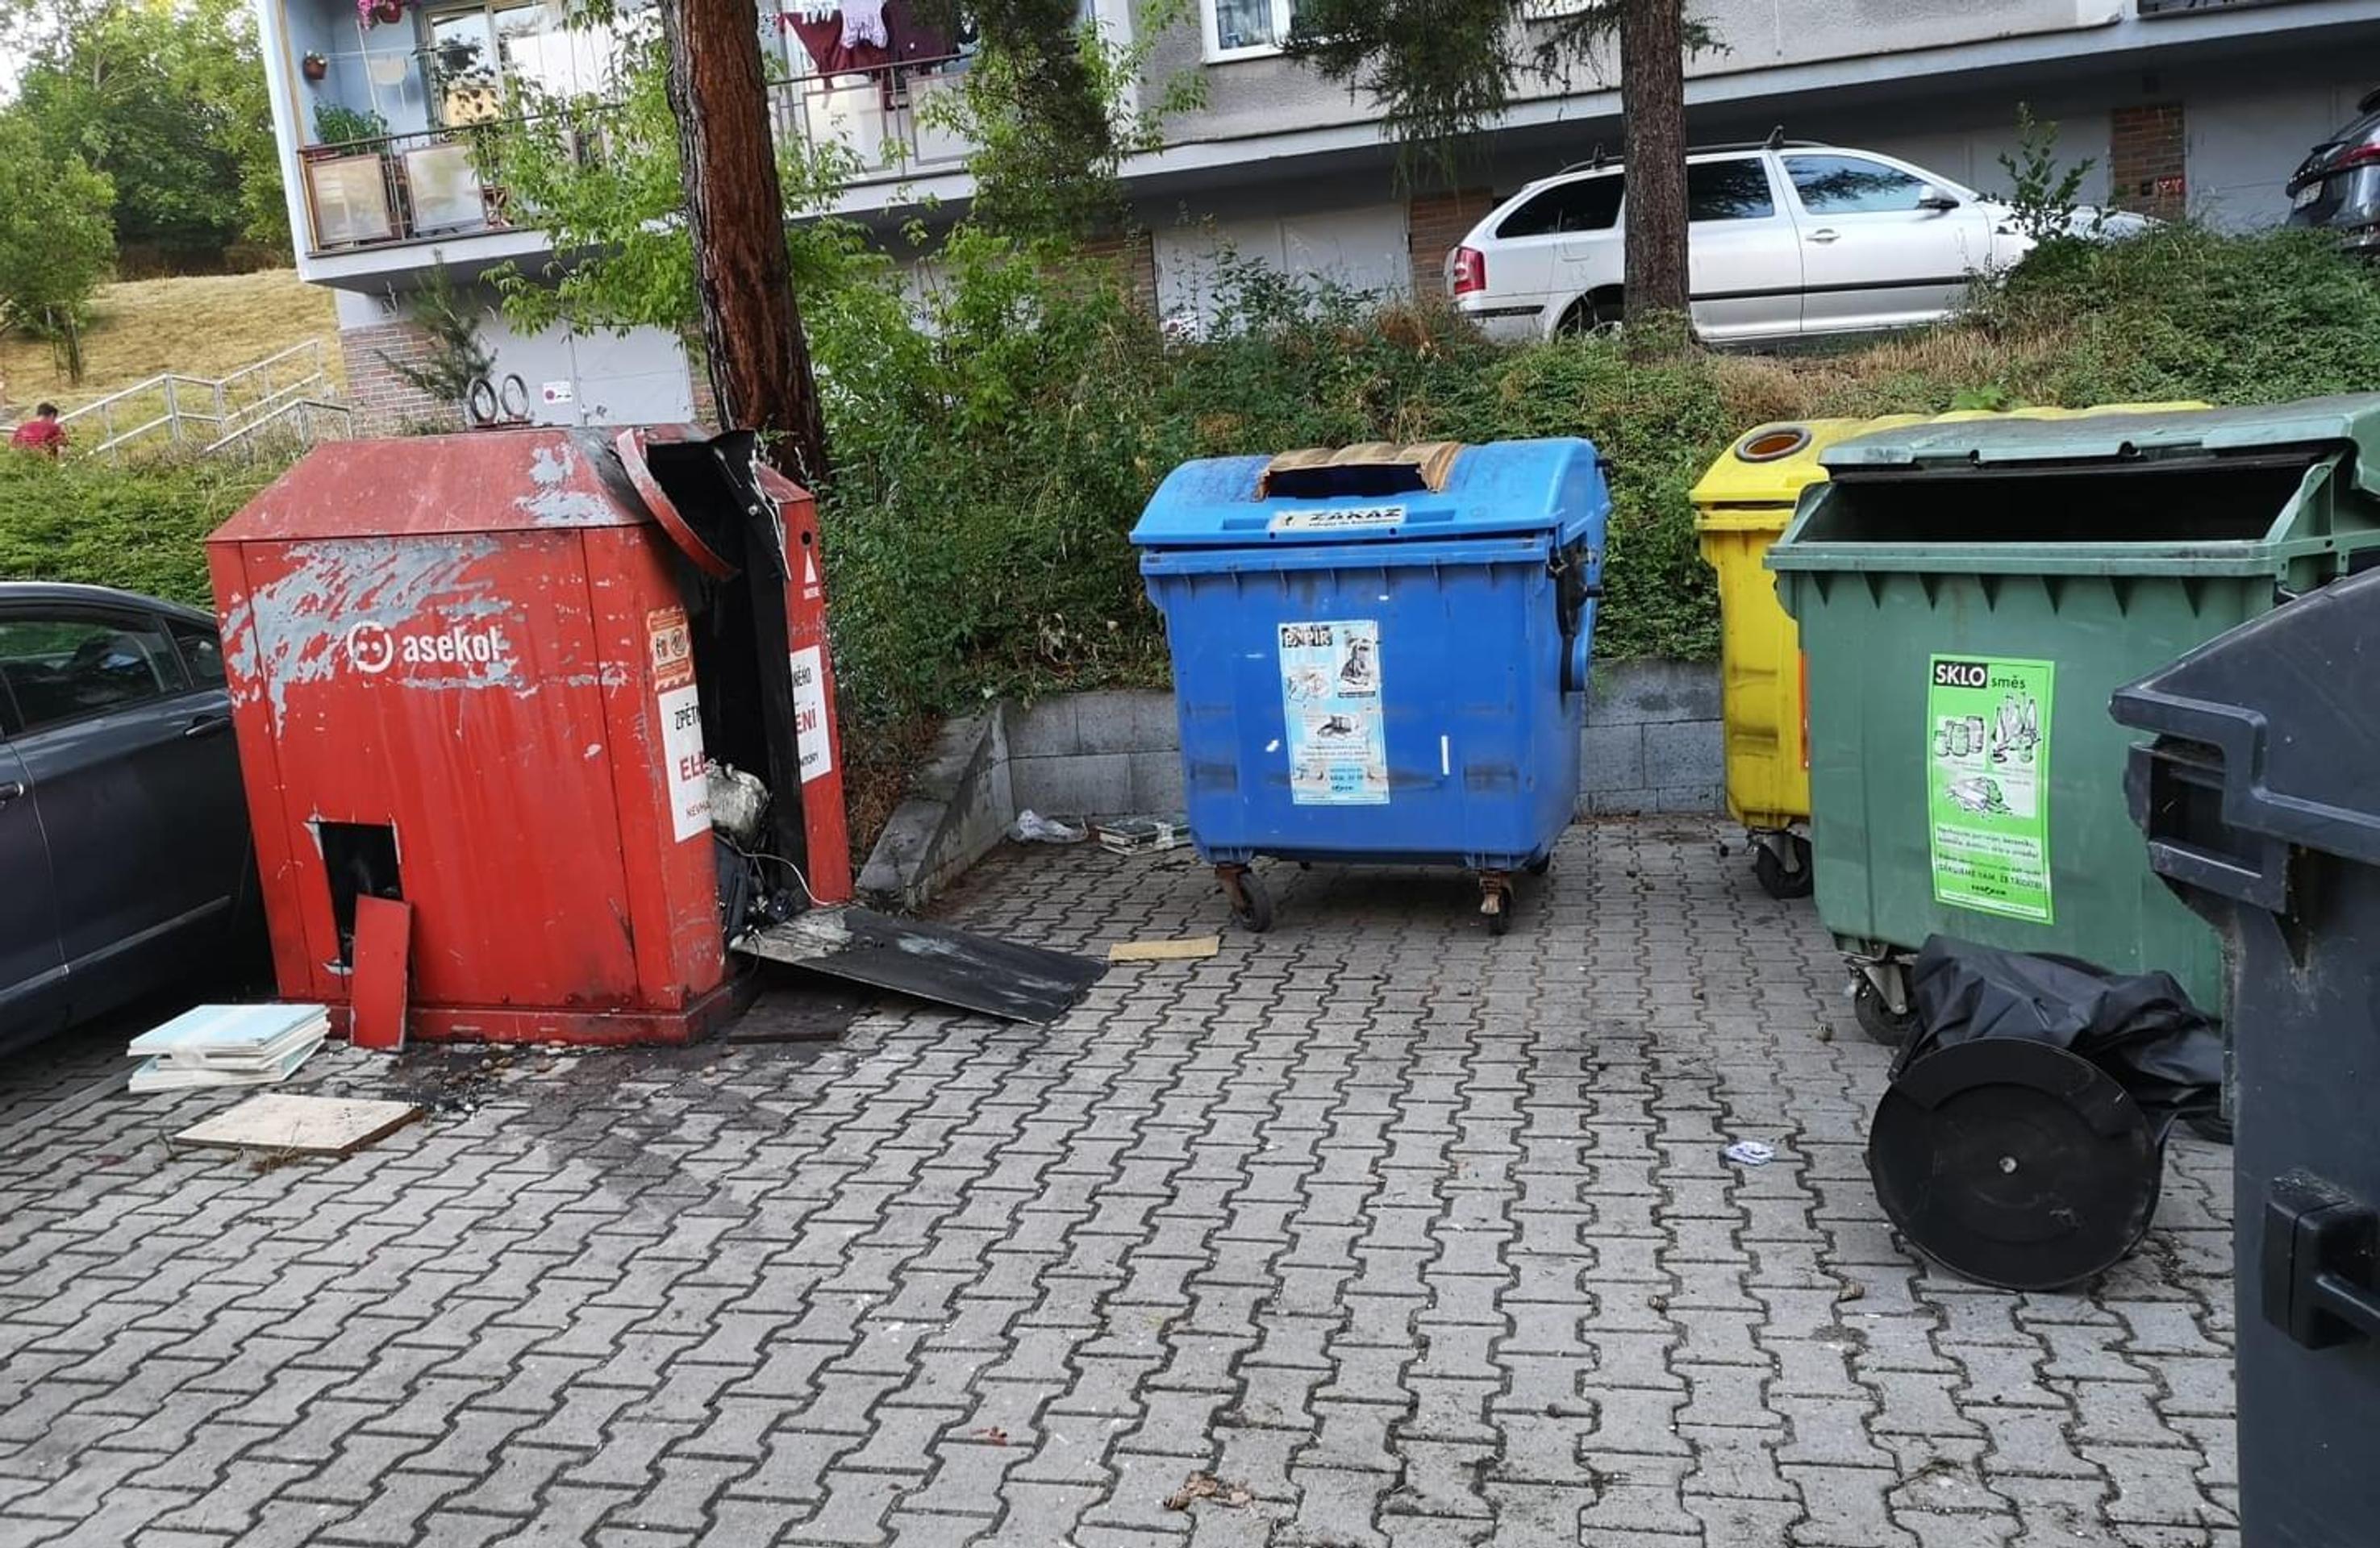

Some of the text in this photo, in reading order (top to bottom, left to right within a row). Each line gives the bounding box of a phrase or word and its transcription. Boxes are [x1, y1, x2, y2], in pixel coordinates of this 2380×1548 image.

[402, 626, 501, 663] asekol
[1935, 664, 2027, 690] SKLO směs
